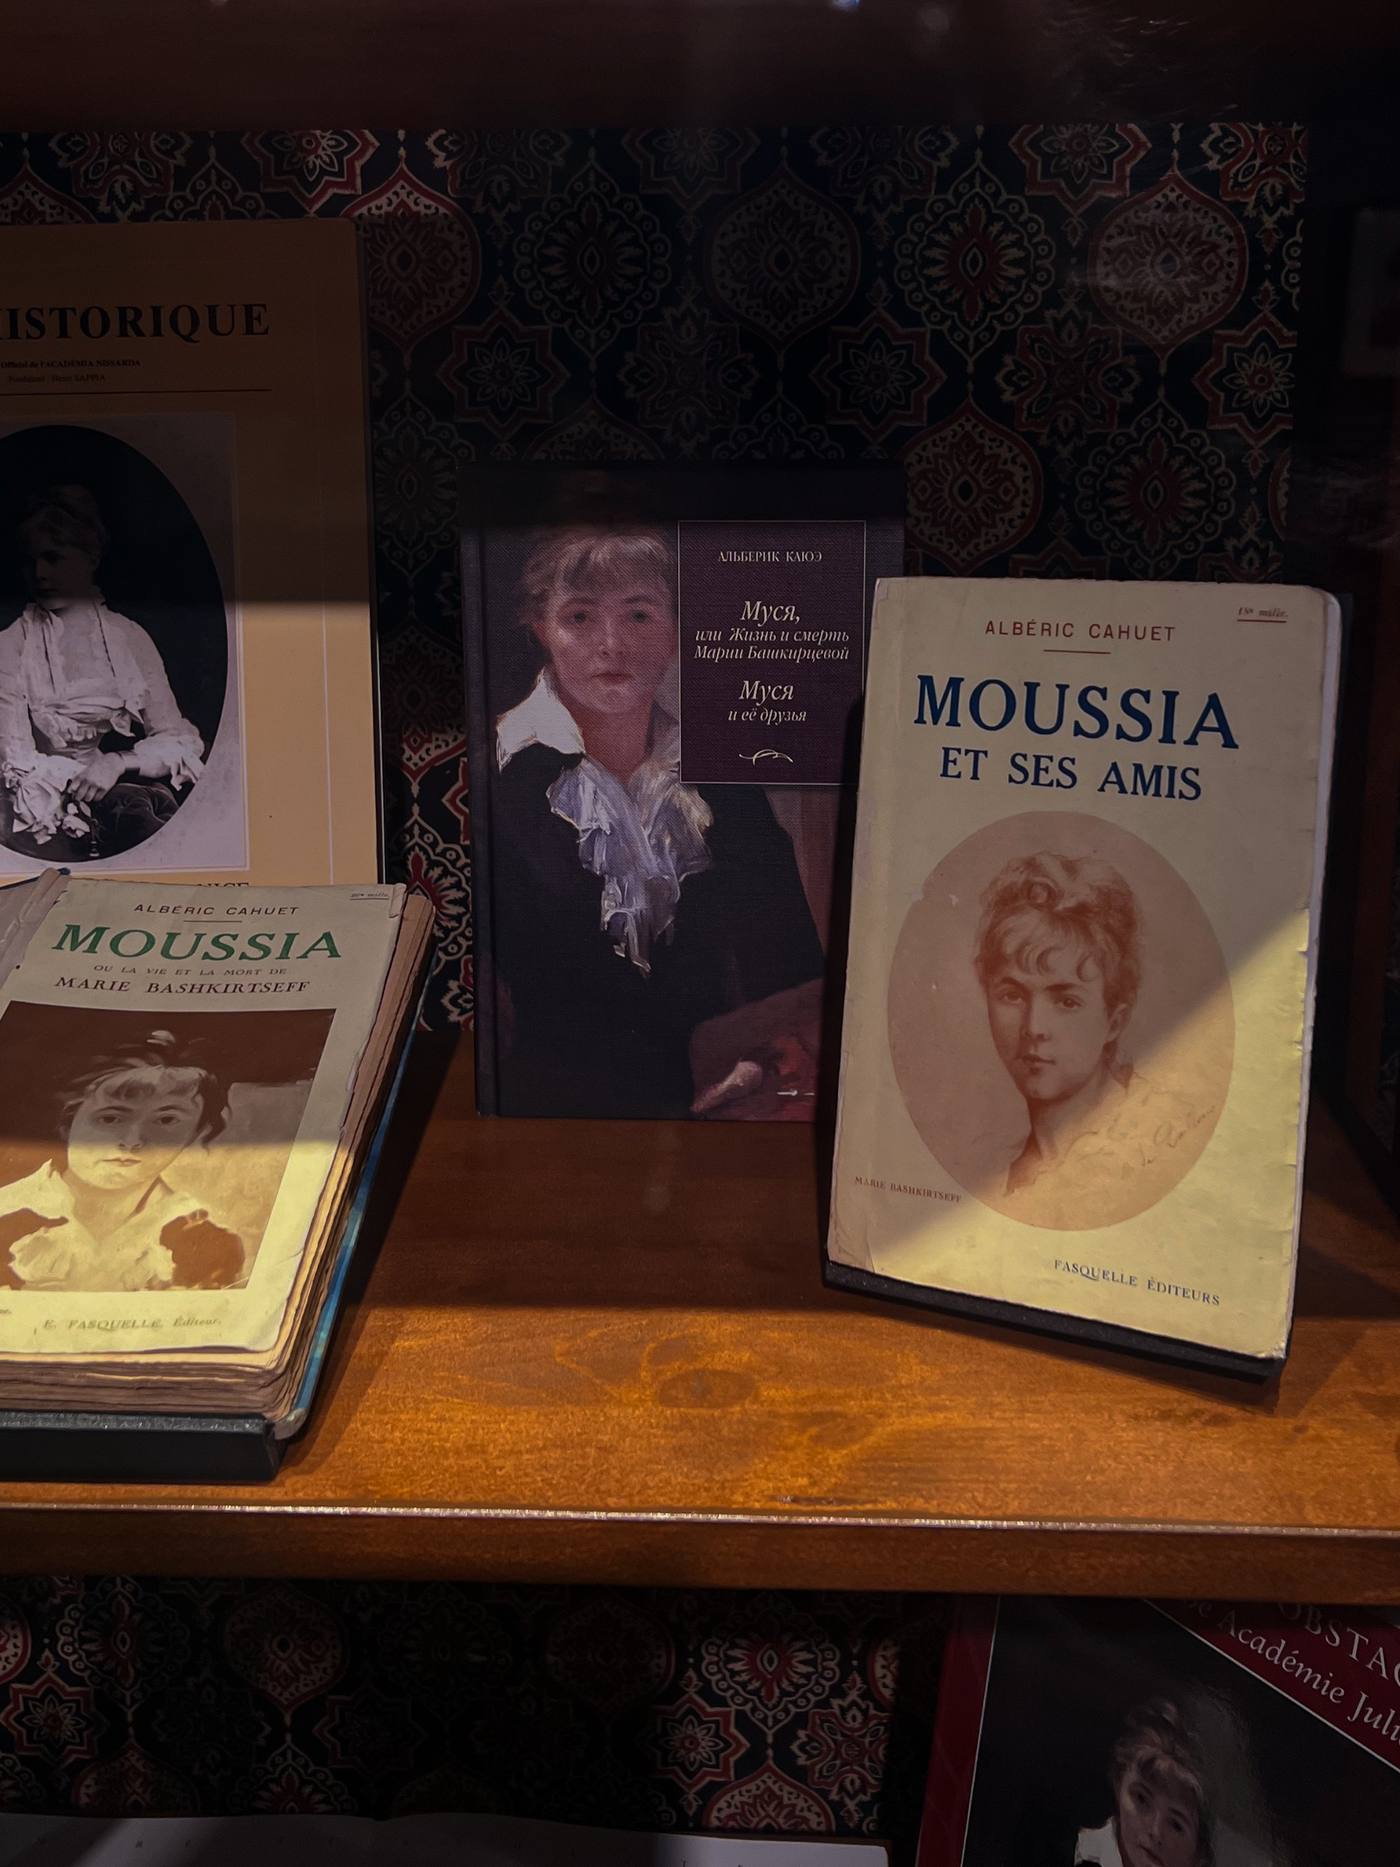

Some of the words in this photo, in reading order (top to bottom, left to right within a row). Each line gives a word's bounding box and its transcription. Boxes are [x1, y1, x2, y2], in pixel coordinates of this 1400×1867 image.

[0, 303, 270, 344] ISTORIQUE
[718, 550, 780, 563] АЛЬБЕРИК
[740, 600, 801, 627] Муся,
[695, 630, 722, 642] или
[729, 627, 777, 643] Жизнь
[780, 631, 790, 642] и
[793, 627, 850, 646] смерть
[984, 619, 1075, 639] ALBÉRIC
[1088, 622, 1177, 642] CAHUET
[694, 645, 744, 663] Марии
[747, 644, 850, 663] Башкирцевой
[738, 680, 794, 706] Муся
[728, 710, 738, 721] и
[741, 707, 757, 721] её
[759, 706, 807, 726] друзья
[913, 674, 1240, 750] MOUSSIA
[939, 747, 988, 782] ET
[1007, 752, 1078, 791] SES
[1097, 761, 1203, 801] AMIS
[133, 903, 216, 916] ALBÉRIC
[225, 904, 300, 916] CAHUET
[51, 923, 342, 962] MOUSSIA
[93, 964, 113, 973] OU
[121, 966, 137, 975] LA
[146, 967, 168, 976] VIE
[175, 968, 191, 976] ET
[199, 968, 216, 976] LA
[223, 968, 261, 976] MORT
[269, 967, 287, 976] DE
[55, 976, 131, 993] MARIE
[146, 979, 311, 994] BASHKIRTSEFF
[854, 1175, 887, 1191] MARIE
[889, 1182, 963, 1205] BASHKIRTSEFF
[1053, 1258, 1139, 1287] FASQUELLE
[1146, 1275, 1221, 1306] ÉDITEURS
[1217, 1609, 1346, 1705] Académie
[1347, 1690, 1400, 1746] Juli
